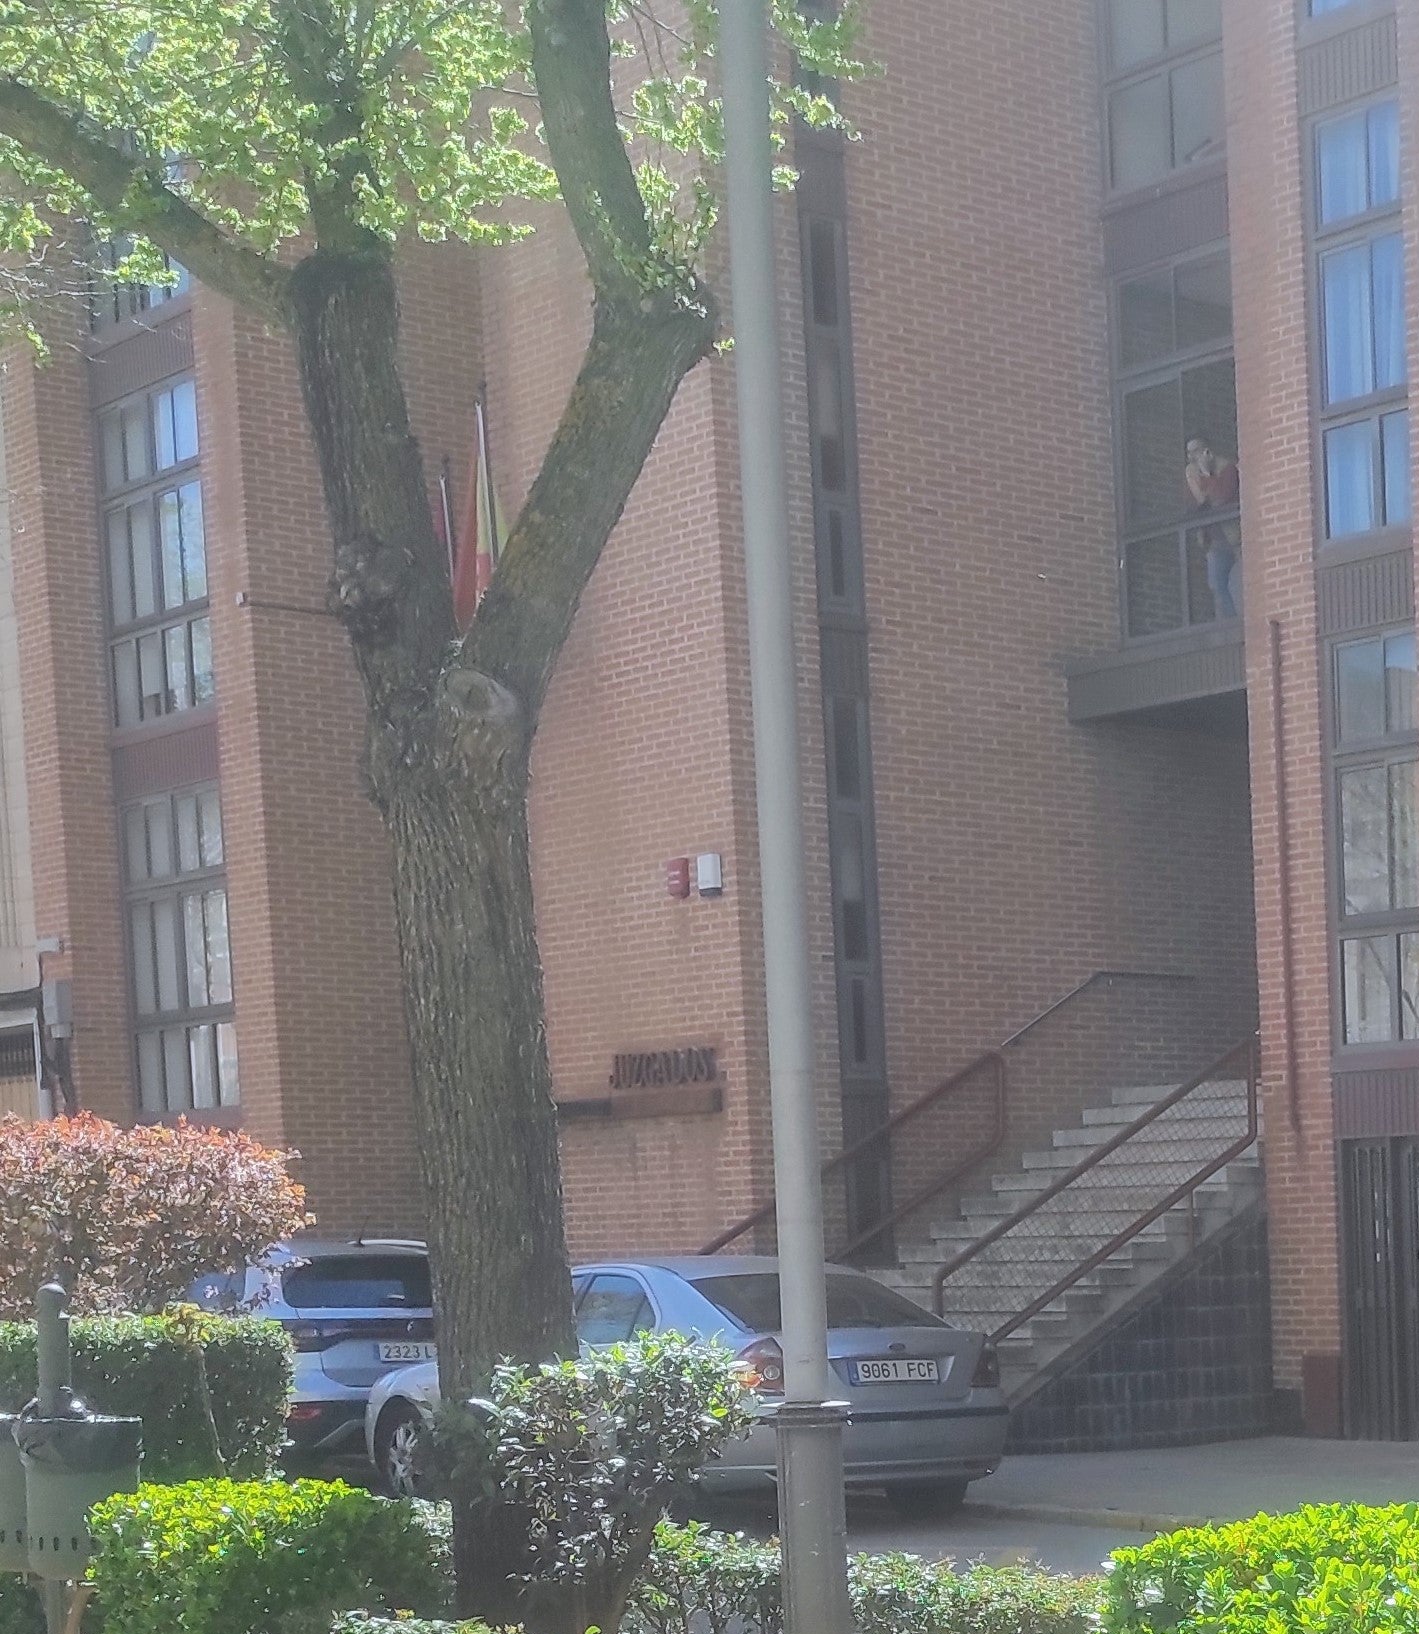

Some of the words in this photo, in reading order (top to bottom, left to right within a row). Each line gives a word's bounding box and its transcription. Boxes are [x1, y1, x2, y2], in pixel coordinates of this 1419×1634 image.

[383, 1344, 420, 1359] 2323
[861, 1362, 899, 1379] 9061
[906, 1362, 935, 1378] FCF
